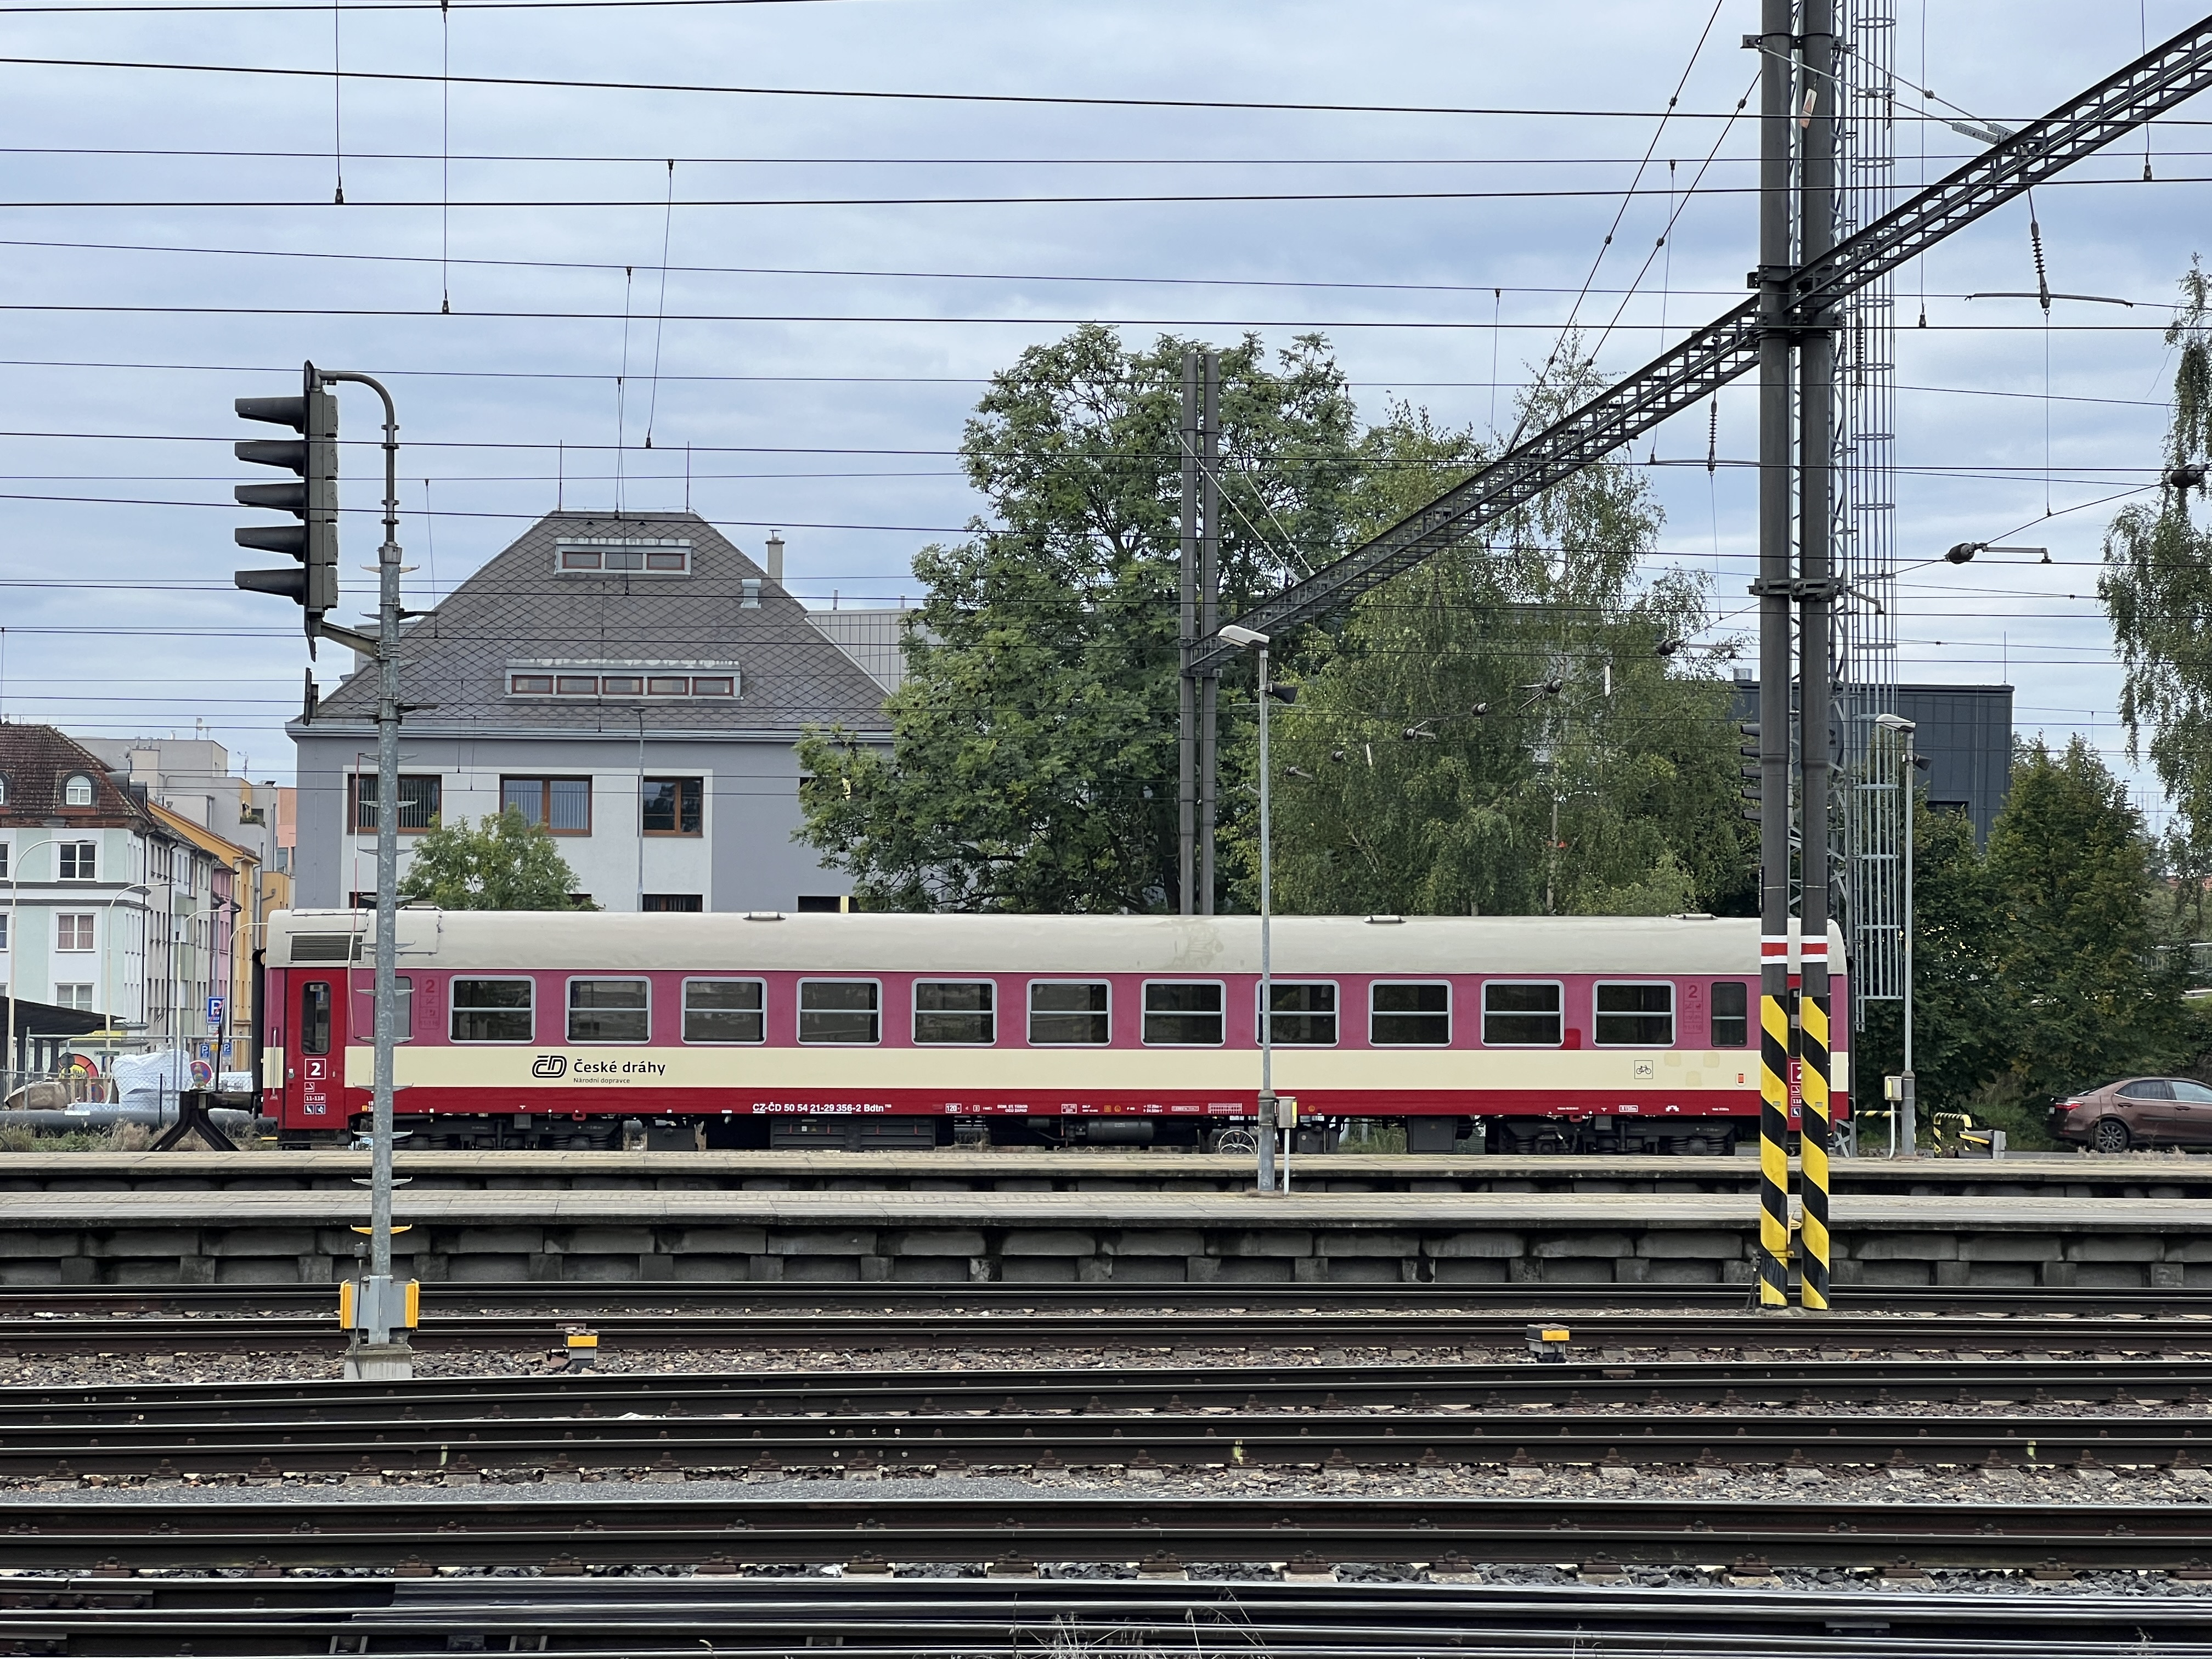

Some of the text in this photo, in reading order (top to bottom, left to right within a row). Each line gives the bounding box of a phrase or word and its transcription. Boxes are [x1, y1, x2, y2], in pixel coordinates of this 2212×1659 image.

[425, 979, 435, 993] 2
[1689, 985, 1697, 998] 2
[211, 1000, 222, 1015] P
[311, 1062, 321, 1076] 2
[574, 1059, 665, 1076] České dráhy
[752, 1102, 782, 1113] CZ-ČD
[784, 1104, 795, 1112] 50
[797, 1104, 808, 1112] 54
[810, 1104, 834, 1113] 21-29
[836, 1104, 861, 1113] 356-2
